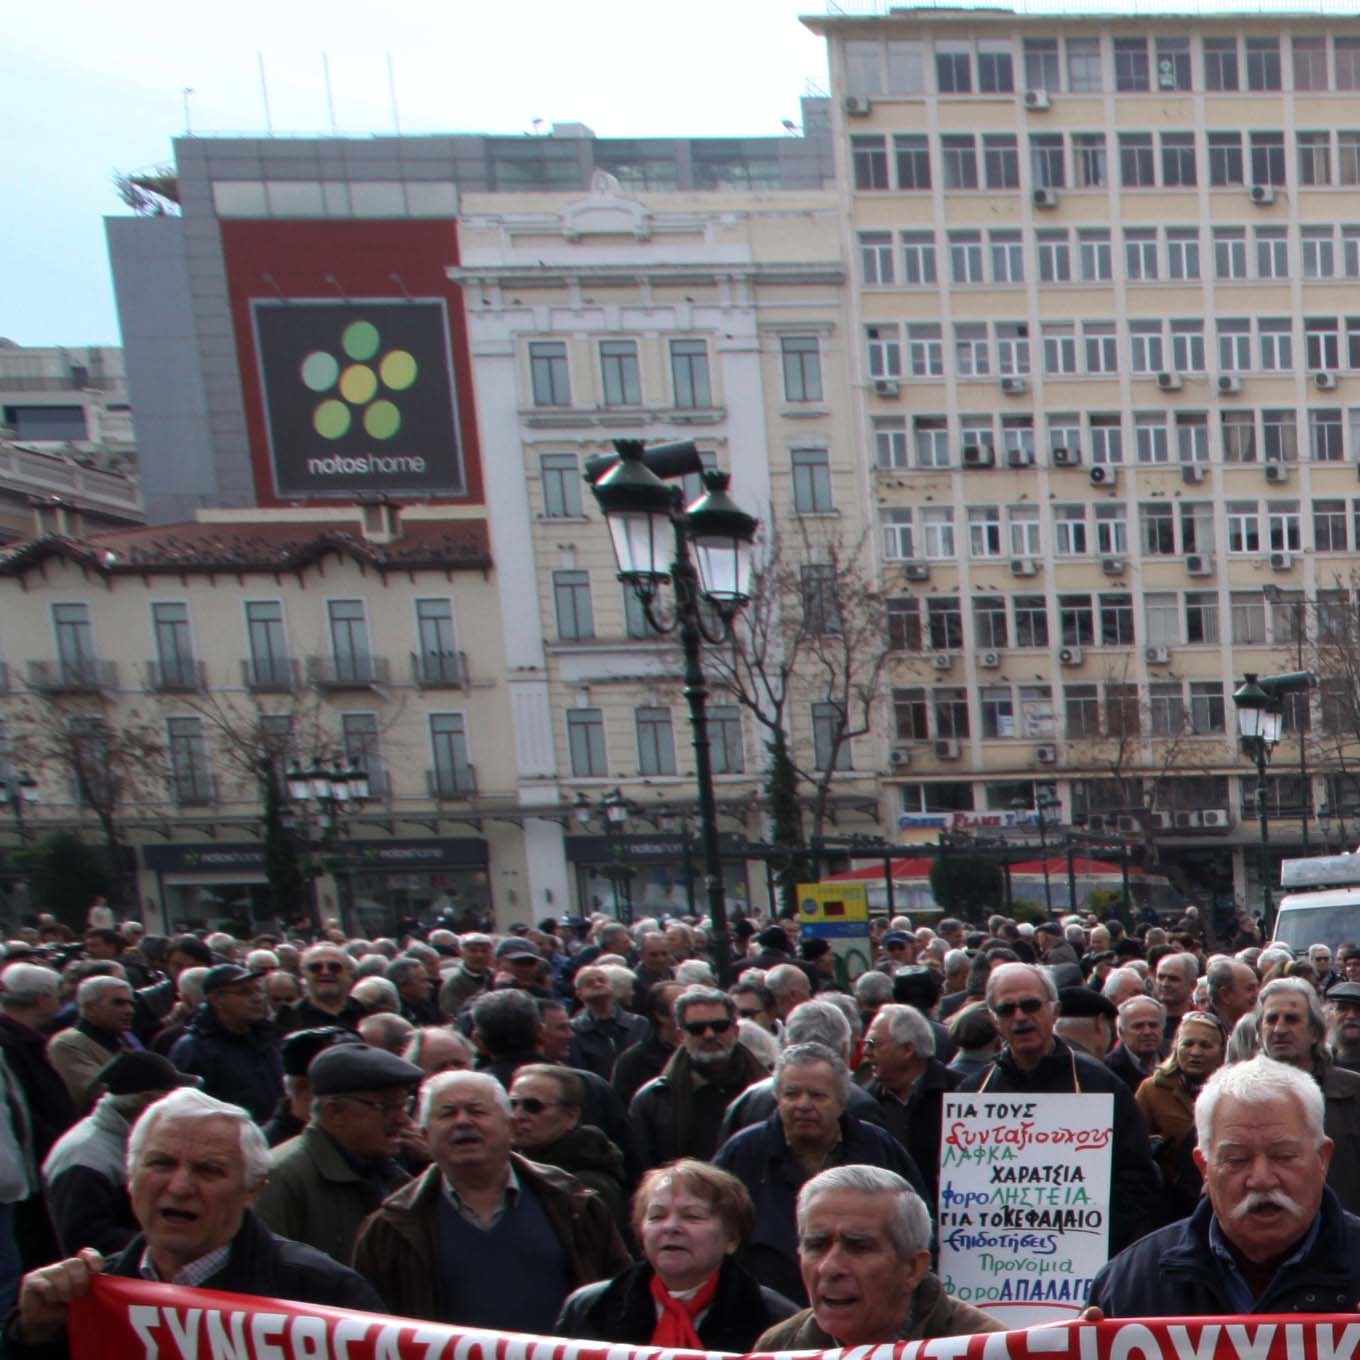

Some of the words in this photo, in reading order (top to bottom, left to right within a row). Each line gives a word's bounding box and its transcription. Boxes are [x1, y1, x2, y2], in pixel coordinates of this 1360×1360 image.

[307, 452, 426, 475] notoshome
[946, 1103, 978, 1119] ΓΙΑ
[984, 1103, 1037, 1119] ΤΟΥΣ
[940, 1211, 972, 1229] ΓΙΑ
